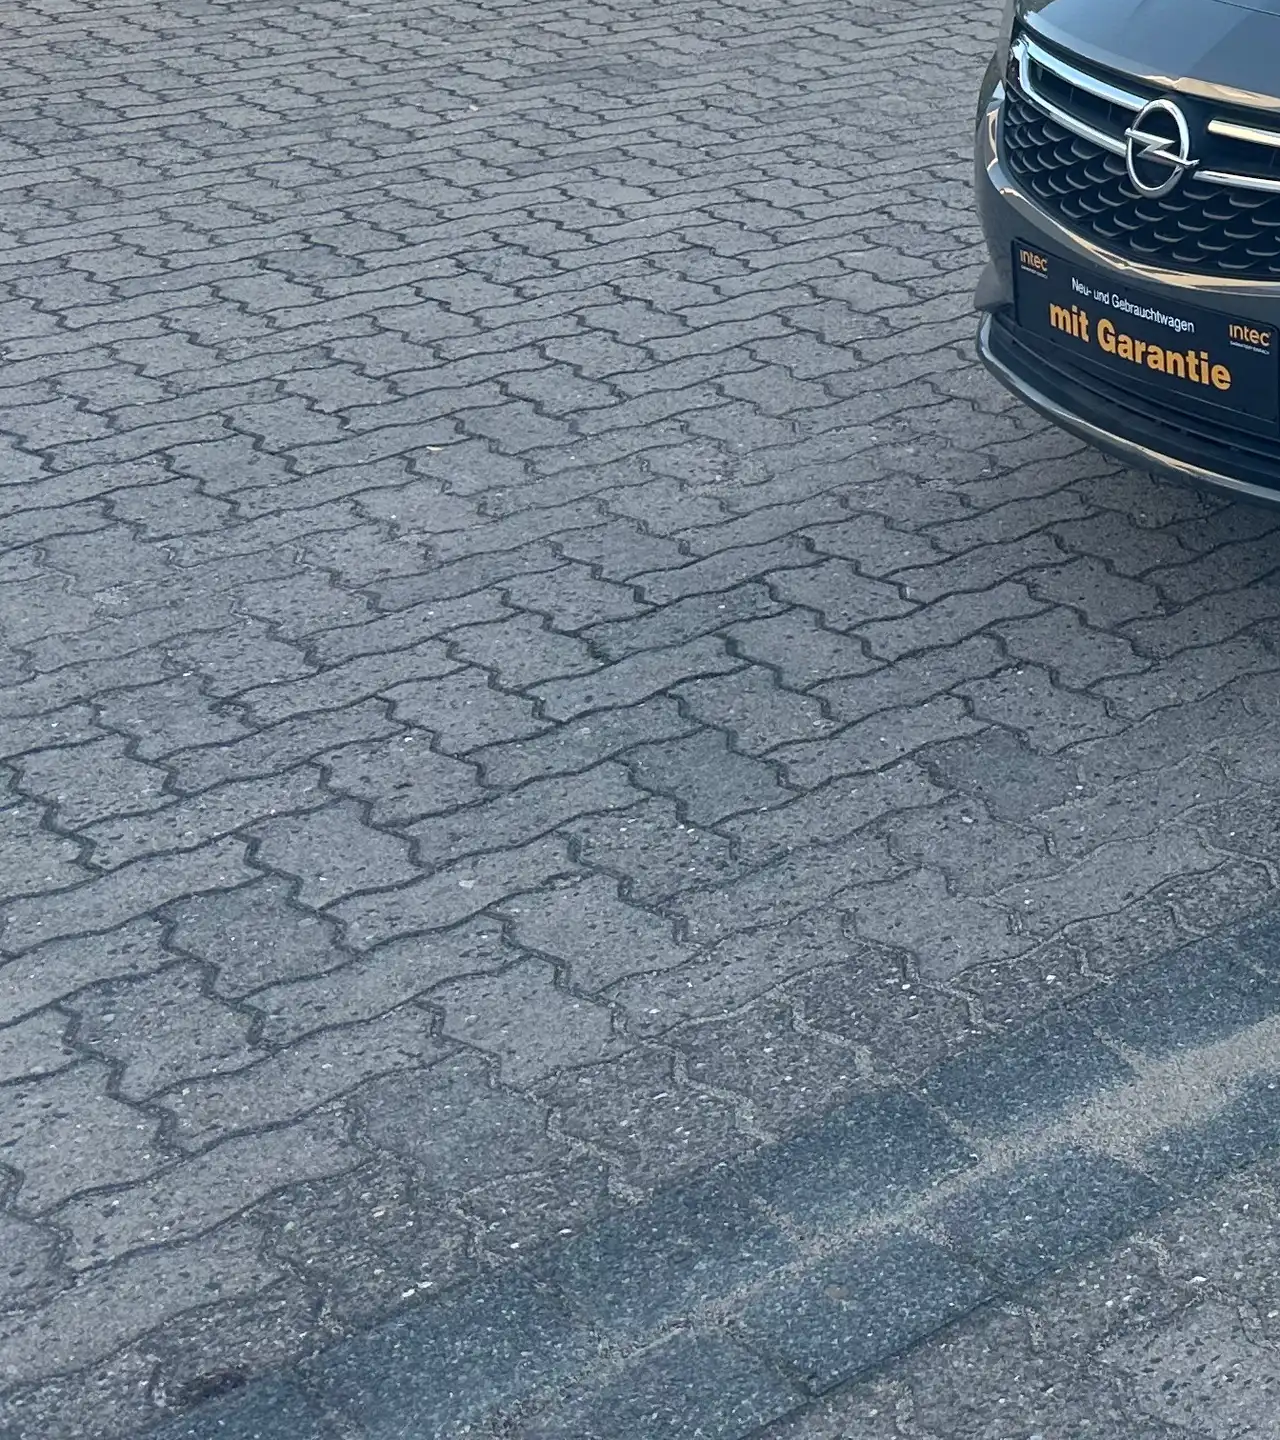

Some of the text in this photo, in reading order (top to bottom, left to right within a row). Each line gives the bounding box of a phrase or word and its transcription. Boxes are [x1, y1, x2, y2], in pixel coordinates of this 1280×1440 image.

[1071, 277, 1195, 333] Neu- und Gebrauchtwagen
[1049, 302, 1232, 391] mit Garantie
